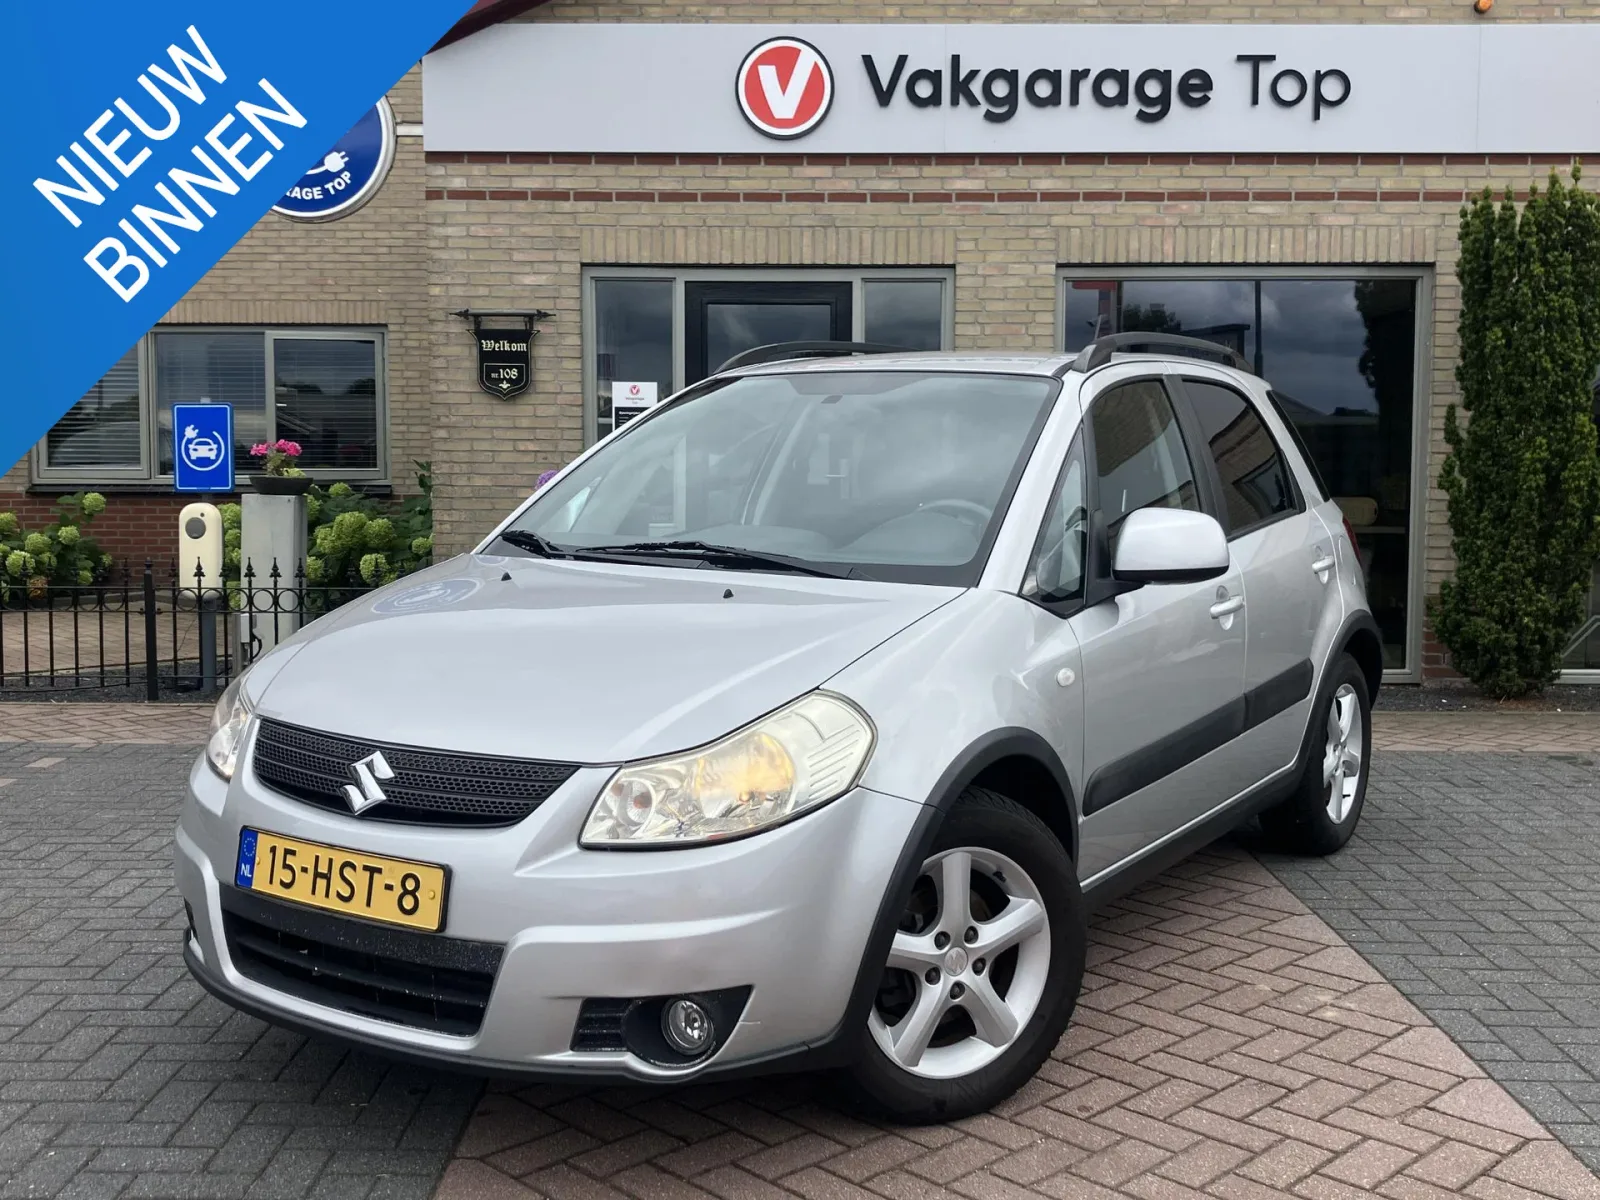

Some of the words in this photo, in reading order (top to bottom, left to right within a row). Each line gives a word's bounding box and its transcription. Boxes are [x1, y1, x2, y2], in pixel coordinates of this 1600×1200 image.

[862, 54, 1213, 123] Vakgarage
[1236, 54, 1351, 121] Top
[286, 187, 323, 200] AGE
[324, 171, 351, 195] TOP
[481, 339, 527, 351] Welkom
[240, 862, 252, 877] NL
[268, 844, 421, 916] 15-HST-8
